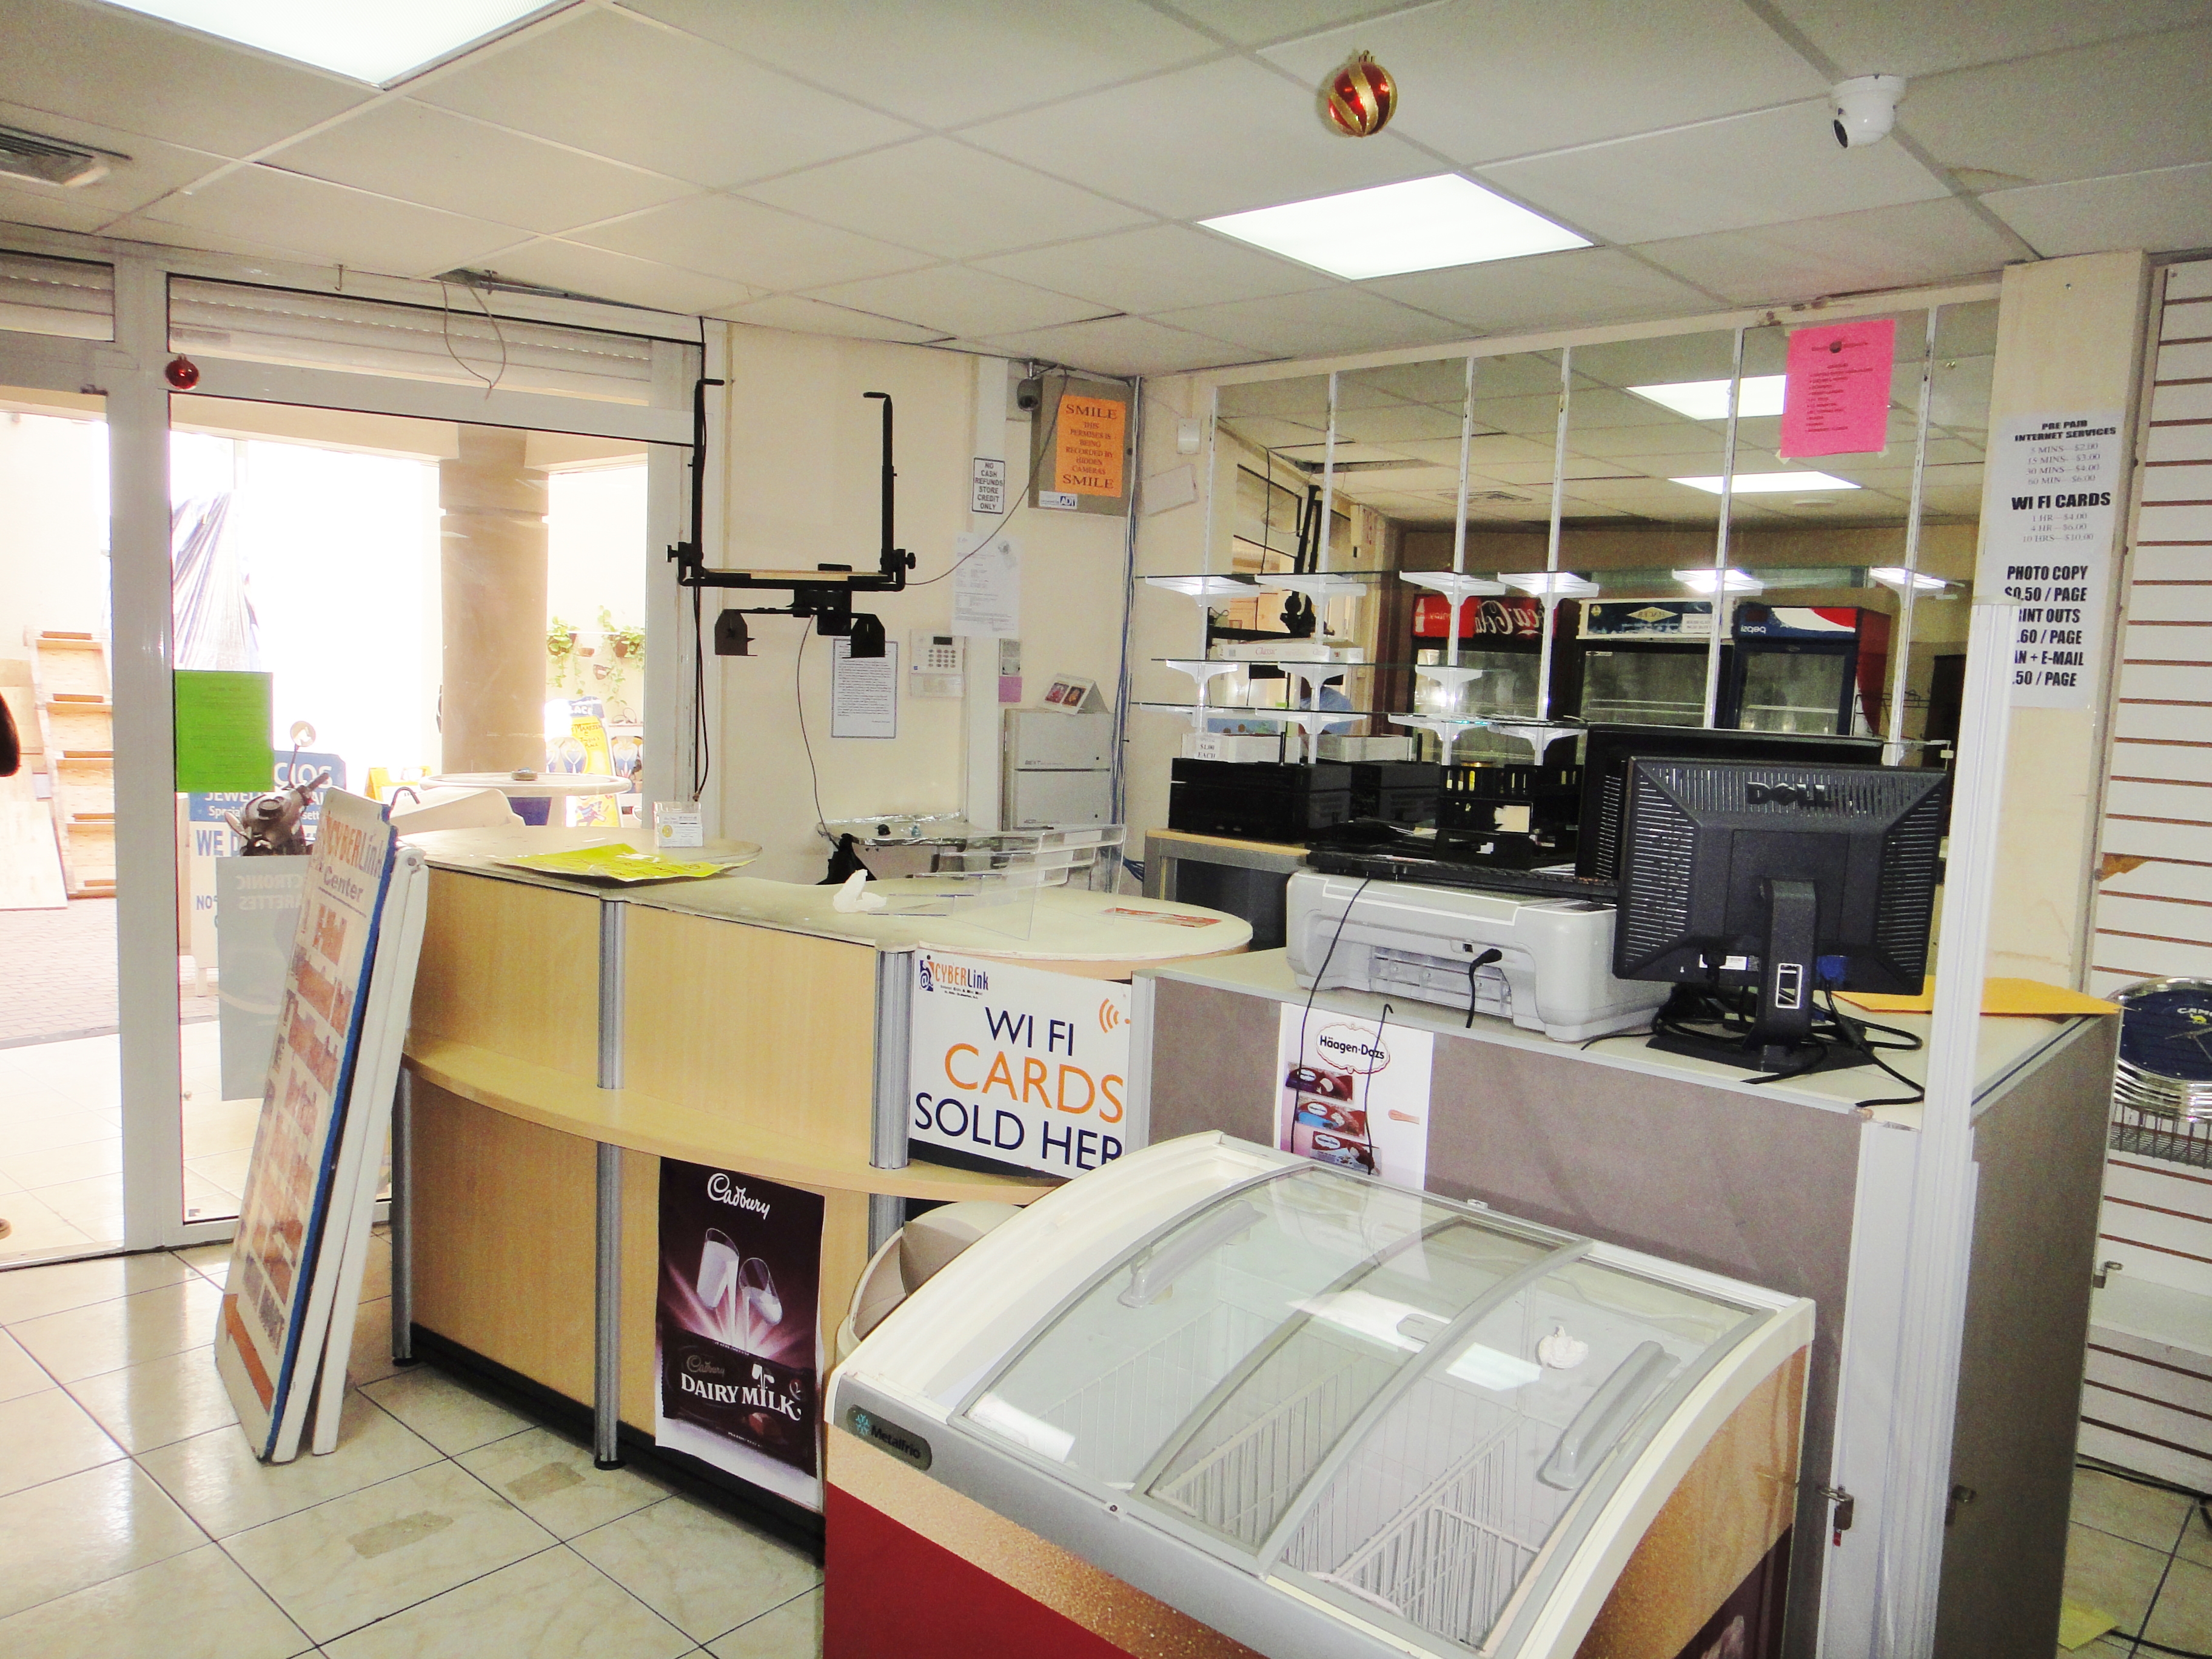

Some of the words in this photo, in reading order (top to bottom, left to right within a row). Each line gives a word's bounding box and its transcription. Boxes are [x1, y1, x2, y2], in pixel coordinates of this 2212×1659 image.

[1065, 404, 1117, 420] SMILE
[2014, 432, 2063, 441] INTERNET
[2065, 427, 2116, 438] SERVICES
[1079, 439, 1101, 447] BEING
[1066, 446, 1103, 457] RECORDED
[1076, 457, 1103, 465] HIDDEN
[1072, 464, 1106, 475] CAMERAS
[974, 477, 1004, 486] REFUNDS
[1062, 474, 1114, 489] SMILE
[977, 494, 999, 503] CREDIT
[1060, 496, 1075, 506] ADT
[2011, 496, 2033, 510] WI
[2038, 495, 2051, 509] FI
[2055, 492, 2111, 508] CARDS
[2006, 565, 2050, 580] PHOTO
[2052, 565, 2088, 580] COPY
[2054, 587, 2088, 602] PAGE
[2046, 608, 2081, 623] OUTS
[2049, 630, 2082, 645] PAGE
[2041, 651, 2084, 665] E-MAIL
[2044, 672, 2077, 686] PAGE
[1747, 782, 1833, 807] DELL
[196, 830, 224, 857] WE
[324, 866, 364, 903] Center
[935, 962, 989, 991] CYBERLink
[985, 1007, 1033, 1048] WI
[1048, 1019, 1074, 1056] FI
[945, 1042, 1124, 1124] CARDS
[915, 1092, 1025, 1150] SOLD
[706, 1173, 770, 1219] Cadbury
[686, 1355, 726, 1378] Cadbury
[680, 1372, 739, 1404] DAIRY
[742, 1385, 802, 1421] MILK
[871, 1425, 921, 1460] Metalfrio
